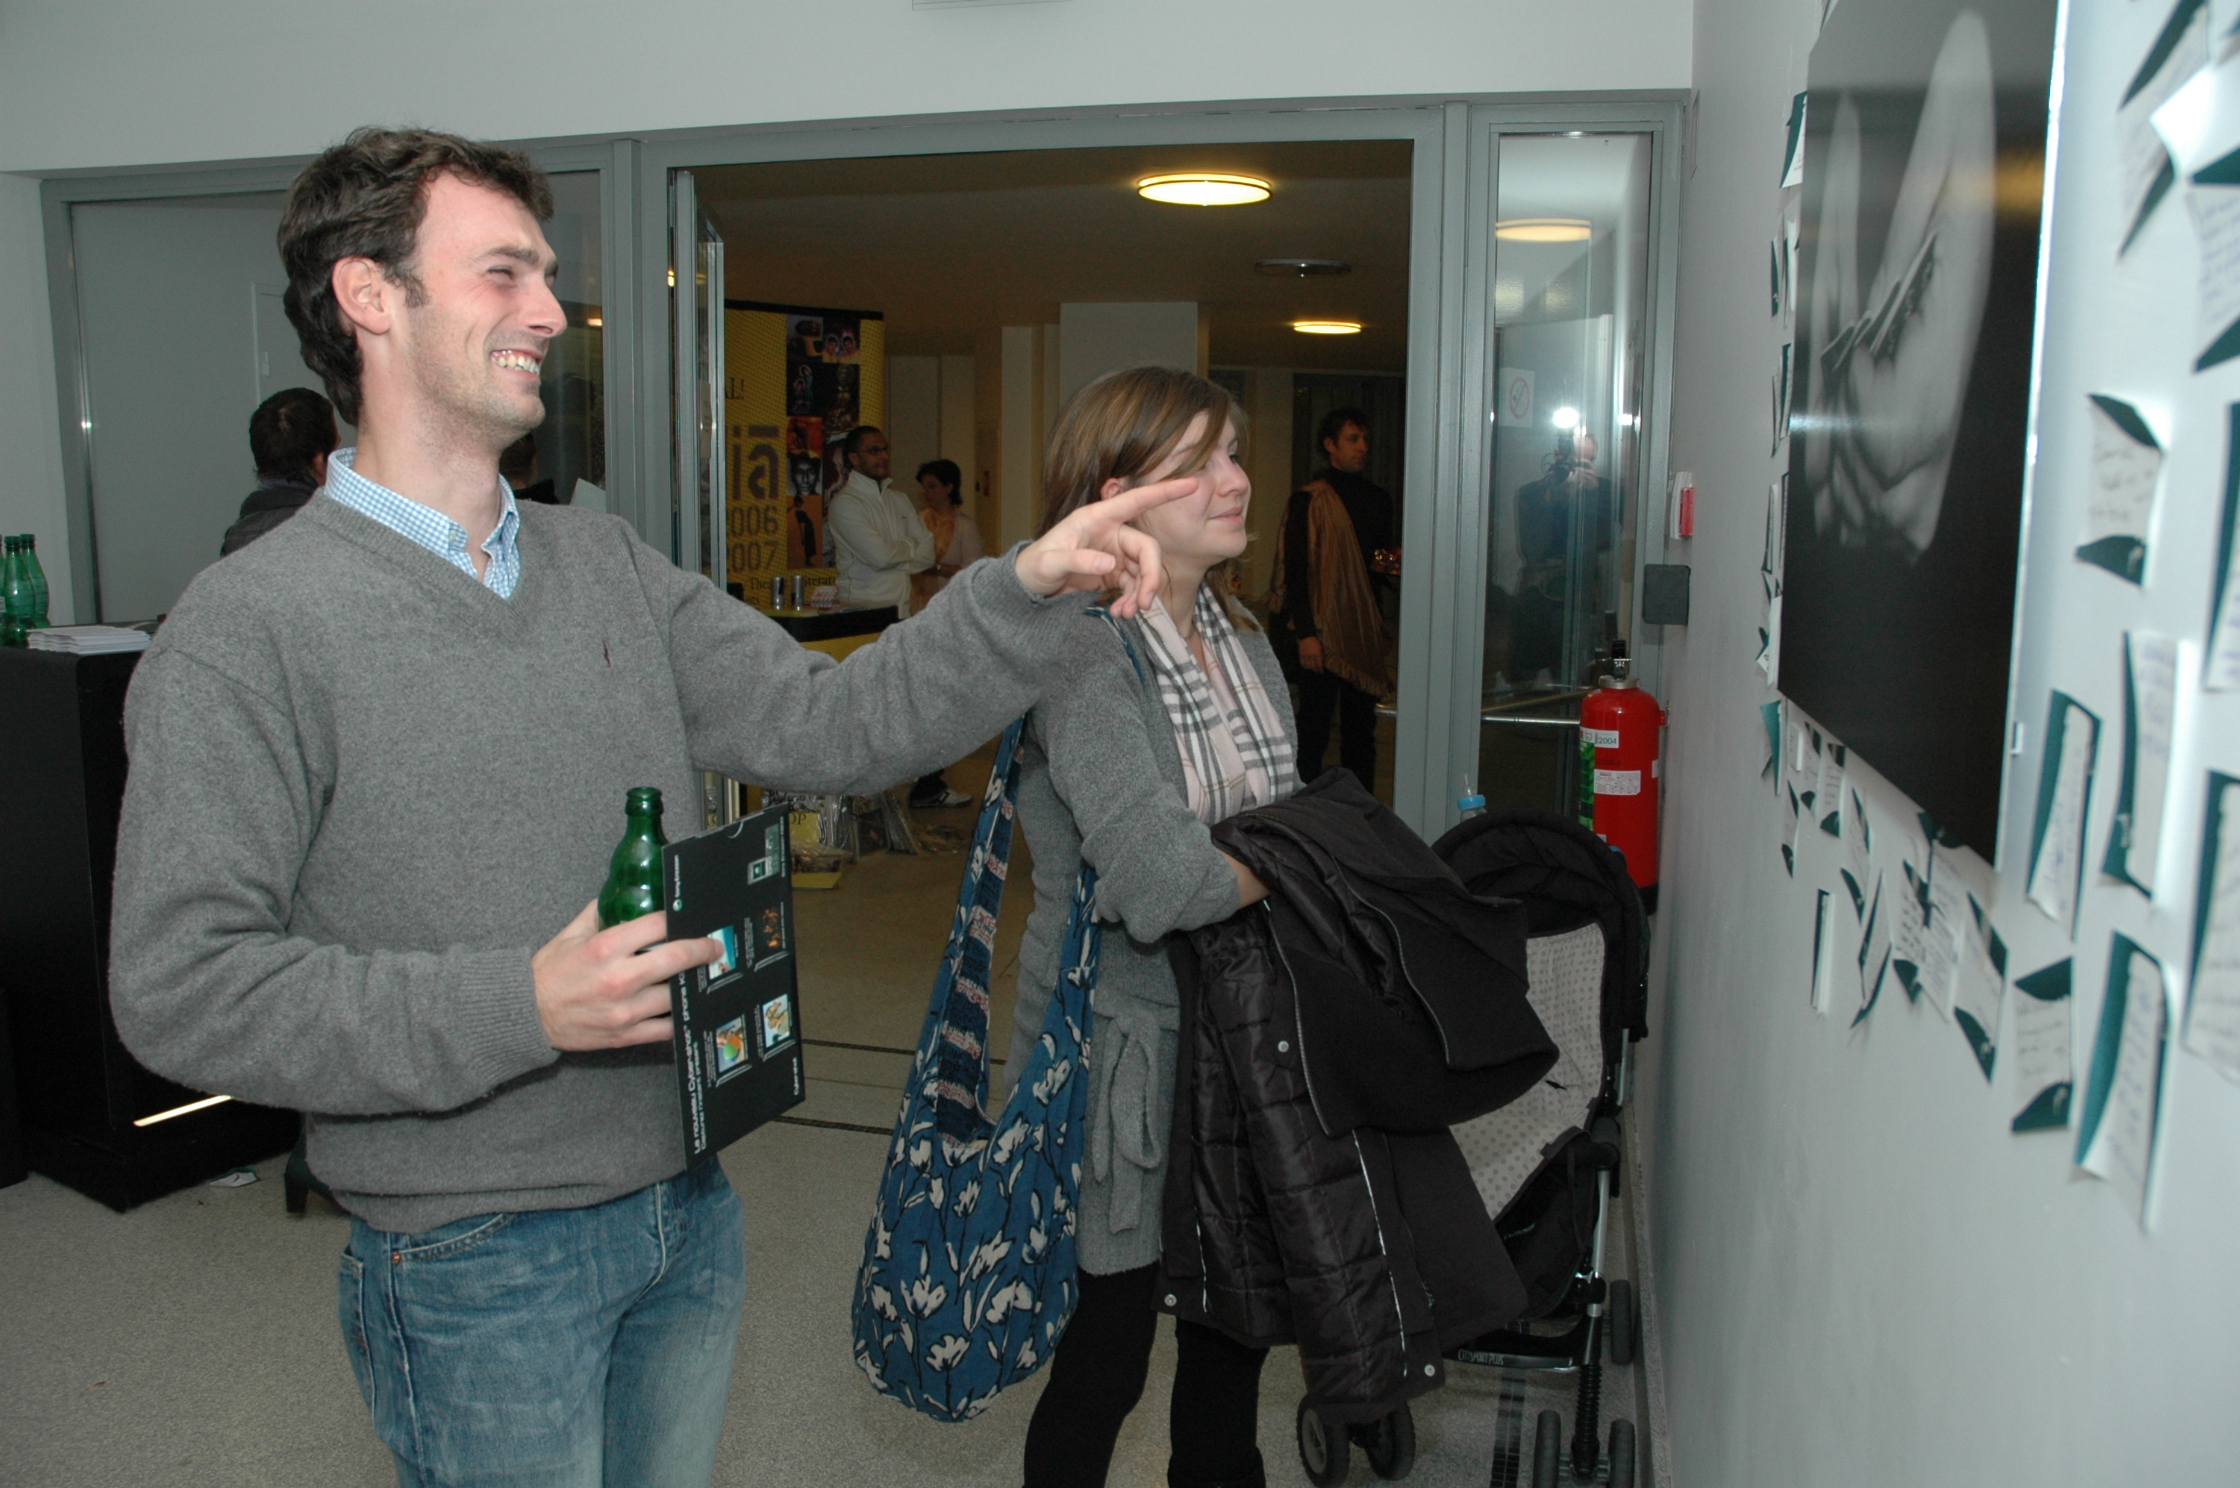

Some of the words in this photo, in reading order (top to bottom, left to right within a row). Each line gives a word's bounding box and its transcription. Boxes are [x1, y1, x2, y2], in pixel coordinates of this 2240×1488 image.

[727, 505, 779, 537] 006
[727, 540, 779, 572] 007
[1598, 736, 1617, 745] 2004
[680, 986, 690, 1021] phone
[690, 1093, 699, 1138] nouveau
